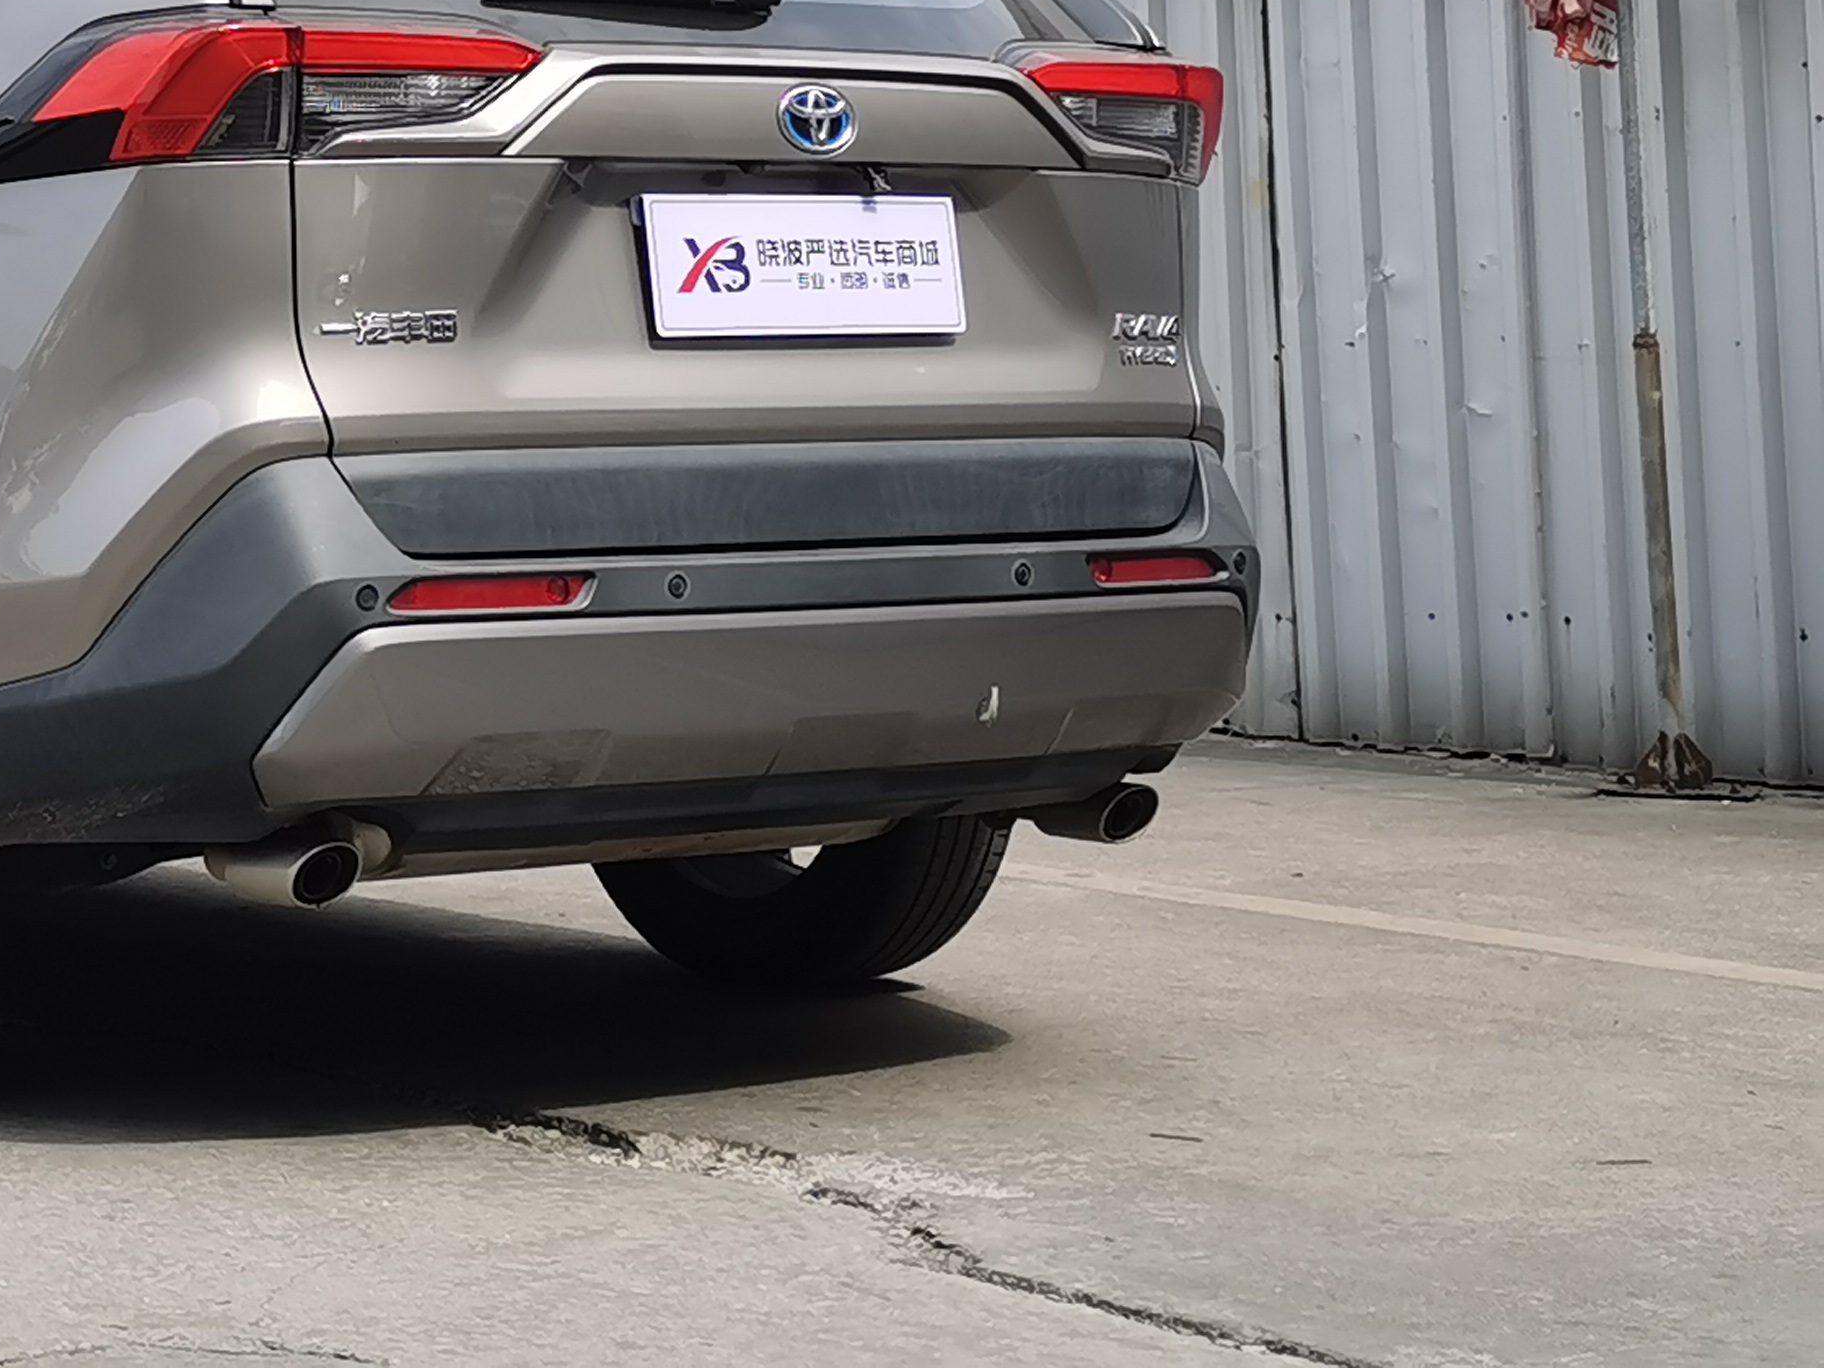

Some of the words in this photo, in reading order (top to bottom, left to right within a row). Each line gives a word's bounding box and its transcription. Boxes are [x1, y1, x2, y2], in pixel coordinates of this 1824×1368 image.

[756, 238, 941, 268] 晓波严选汽车商城
